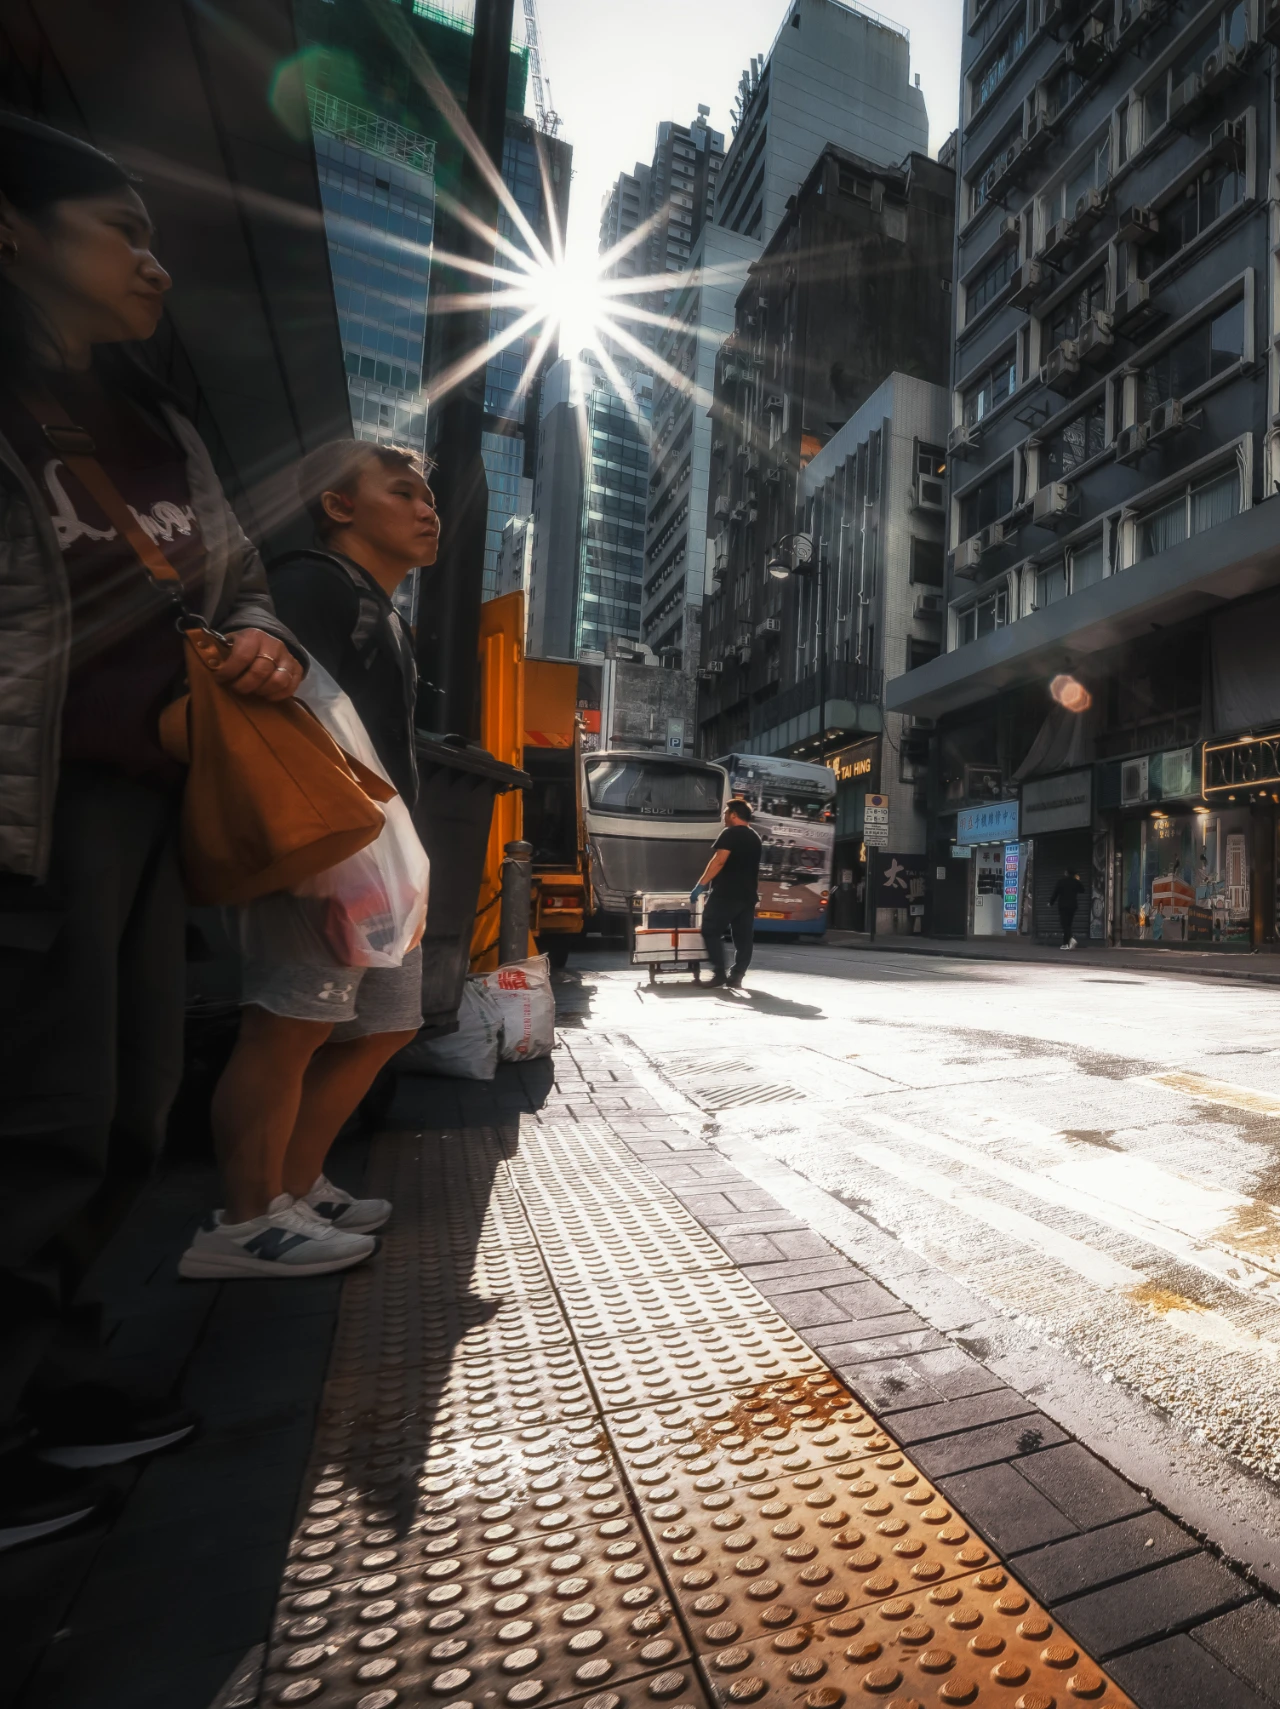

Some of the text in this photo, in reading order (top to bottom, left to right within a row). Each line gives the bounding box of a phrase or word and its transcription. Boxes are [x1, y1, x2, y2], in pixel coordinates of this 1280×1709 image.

[841, 758, 871, 780] TAI HING
[640, 806, 674, 815] ISUZU
